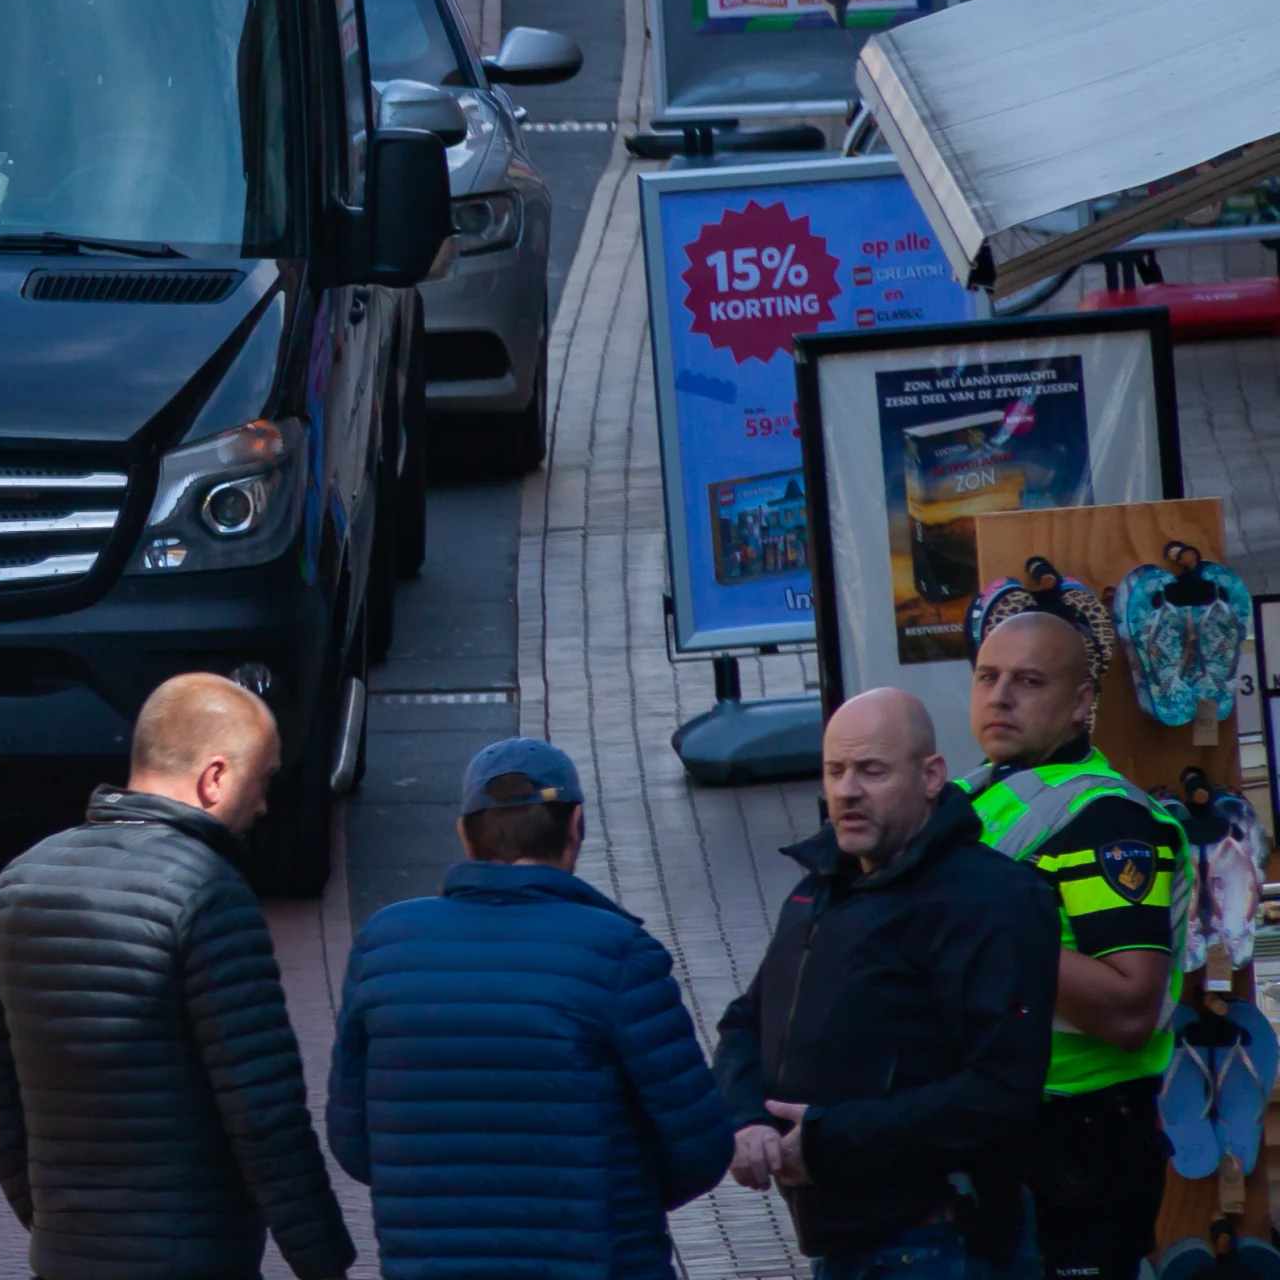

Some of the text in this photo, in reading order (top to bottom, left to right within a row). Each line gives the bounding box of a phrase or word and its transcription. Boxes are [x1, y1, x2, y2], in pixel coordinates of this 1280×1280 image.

[861, 232, 931, 260] op alle
[706, 244, 809, 293] 15%
[875, 264, 945, 282] CREATOR
[710, 294, 821, 322] KORTING
[883, 290, 904, 301] en
[959, 370, 1058, 388] LANGVERWACHTE
[885, 382, 1079, 408] ZESDE DEEL VAN DE ZEVEN ZUSSEN
[954, 468, 996, 494] ZON
